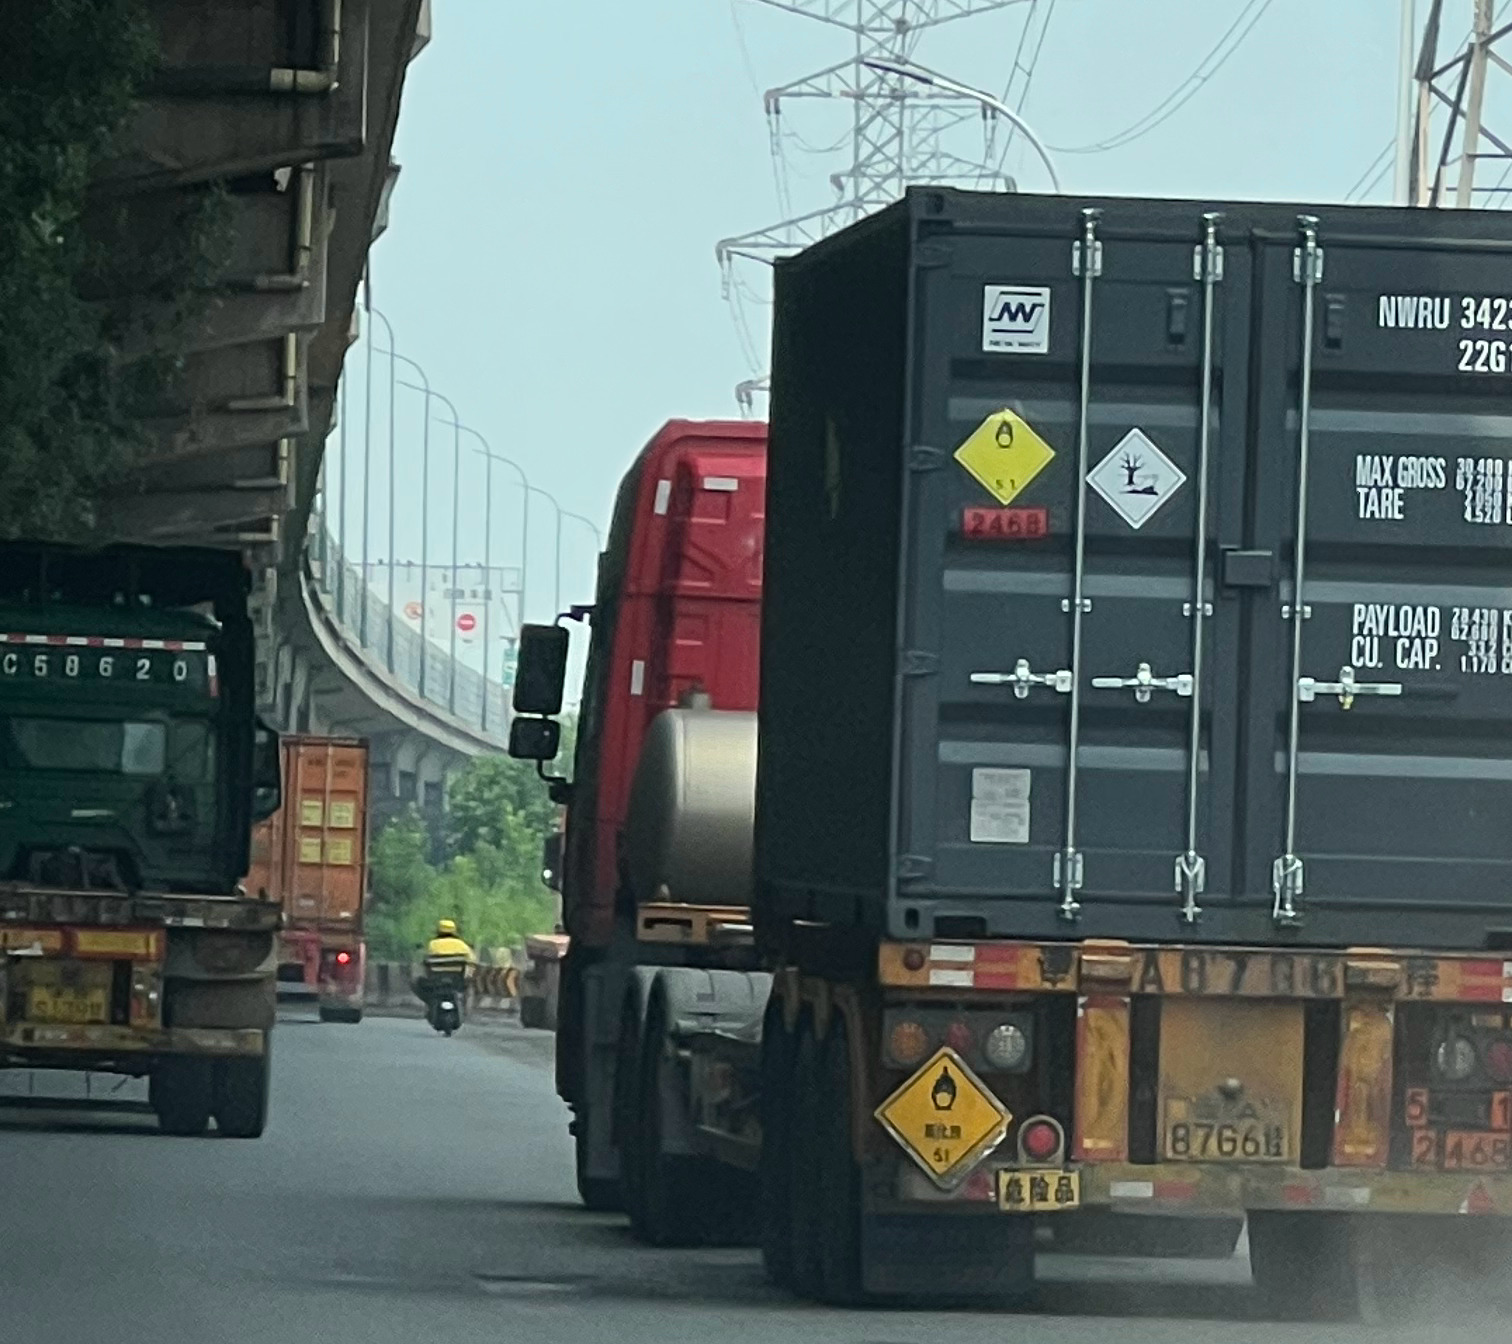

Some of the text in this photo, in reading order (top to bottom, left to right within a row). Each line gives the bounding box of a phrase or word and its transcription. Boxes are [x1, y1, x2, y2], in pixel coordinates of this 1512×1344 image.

[1379, 296, 1450, 329] NWRU
[1356, 455, 1394, 487] MAX
[1397, 457, 1446, 489] GROSS
[1356, 487, 1405, 520] TARE
[1352, 603, 1441, 638] PAYLOAD
[1396, 638, 1441, 671] CAP.
